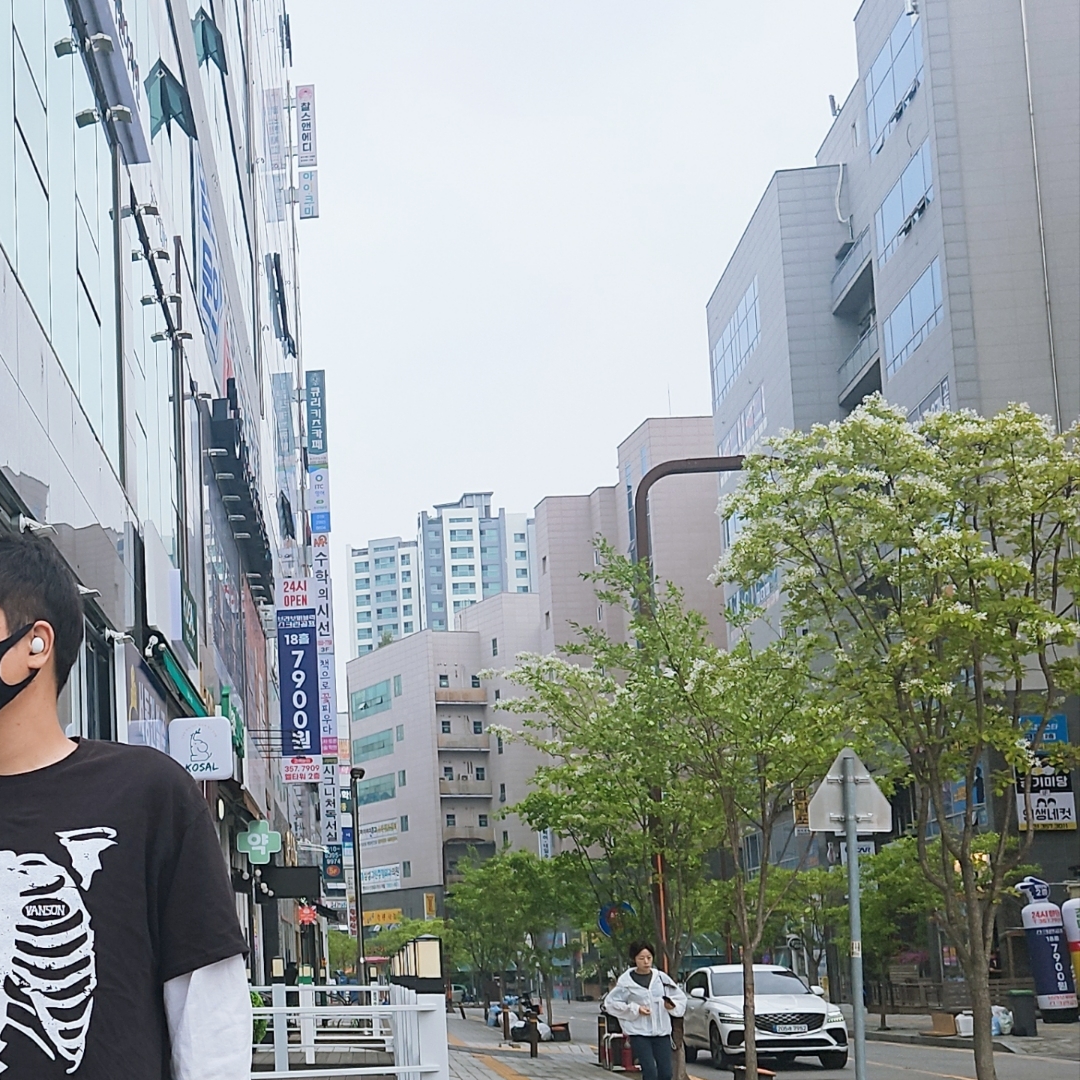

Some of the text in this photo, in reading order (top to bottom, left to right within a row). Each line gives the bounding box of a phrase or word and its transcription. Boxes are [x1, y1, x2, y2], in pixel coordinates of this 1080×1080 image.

[283, 580, 307, 593] 24시
[283, 594, 308, 607] OPEN
[284, 633, 310, 646] 18홀
[185, 762, 219, 773] KOSAL
[247, 833, 269, 855] 약
[25, 904, 66, 917] VANSON
[1051, 944, 1067, 990] 7900원
